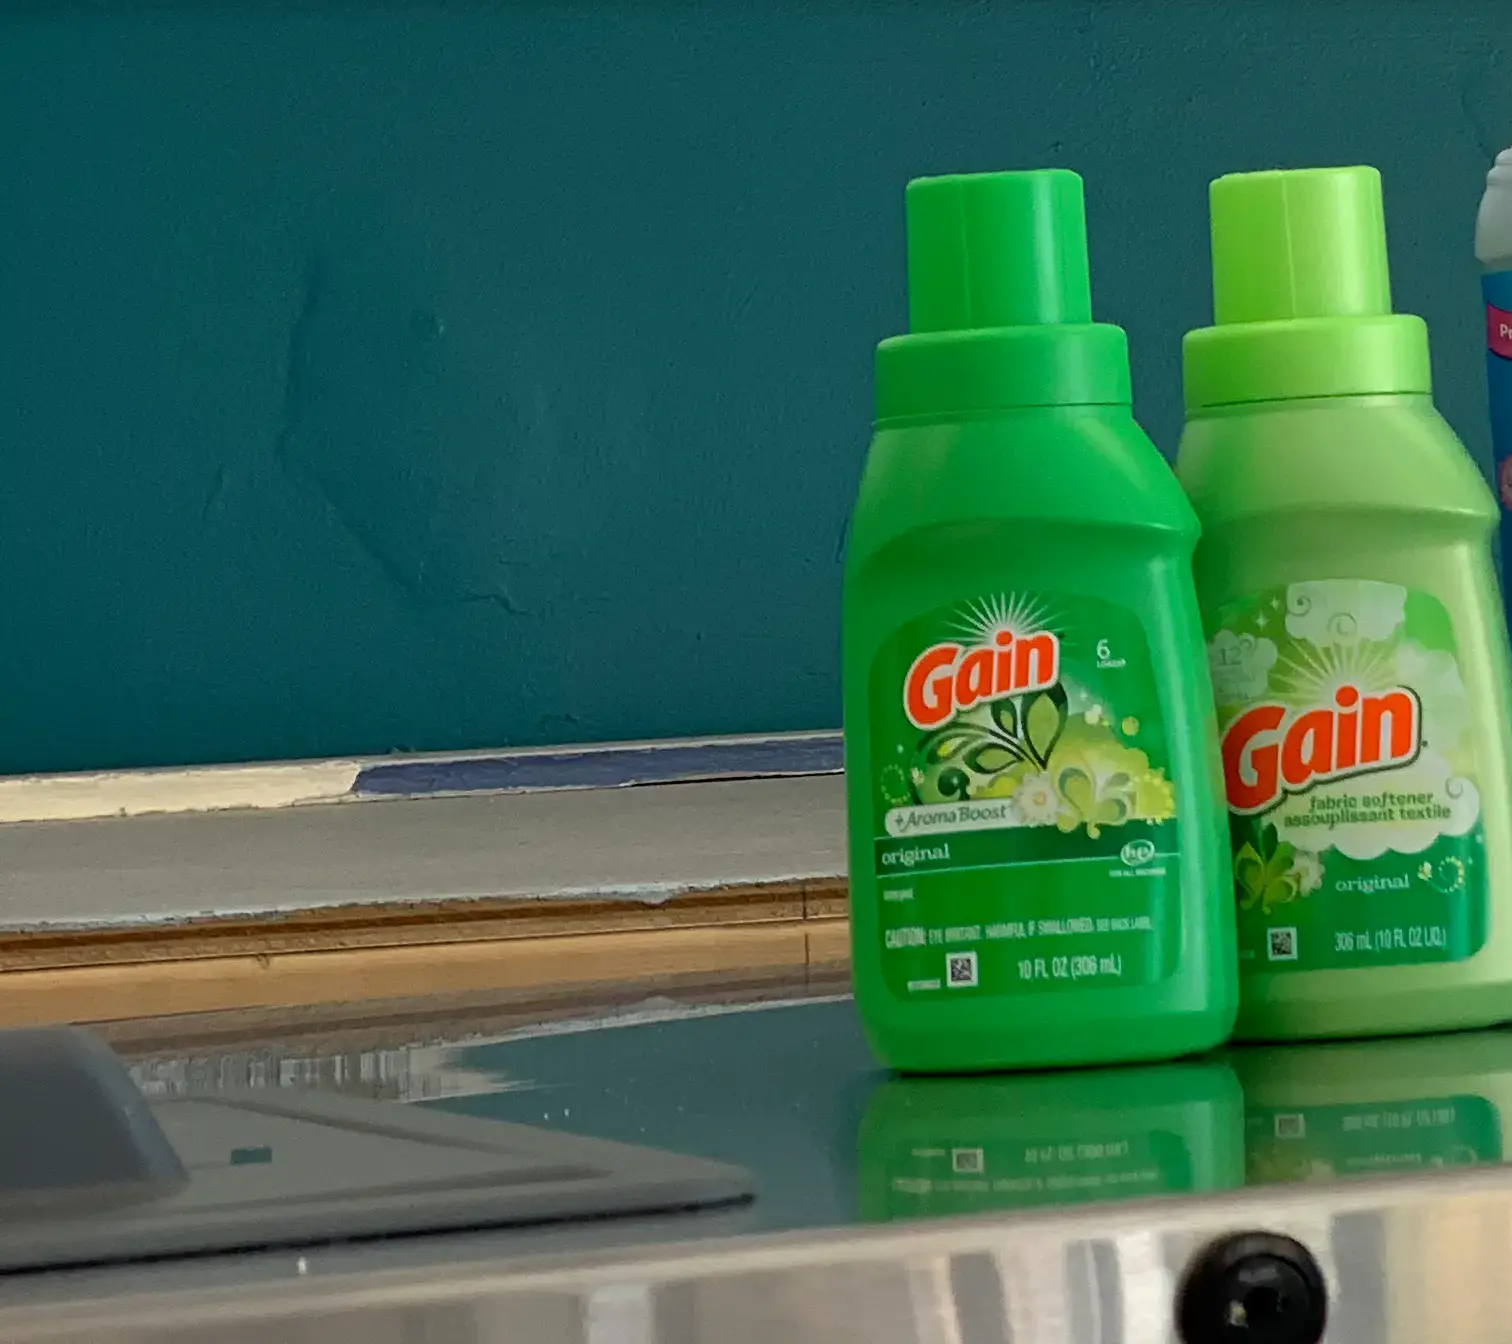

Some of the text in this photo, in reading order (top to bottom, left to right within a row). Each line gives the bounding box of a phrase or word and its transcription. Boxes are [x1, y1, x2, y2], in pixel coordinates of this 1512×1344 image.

[1096, 638, 1111, 660] 6
[905, 629, 1058, 728] Gain
[1221, 684, 1414, 811] Gain
[1309, 791, 1434, 813] fabric softener
[1283, 804, 1452, 831] assouplissant textile
[881, 842, 951, 868] original
[1334, 873, 1410, 894] original
[1017, 959, 1033, 980] 10
[1034, 957, 1050, 980] FL
[1051, 955, 1070, 978] OZ
[1070, 955, 1098, 981] (306
